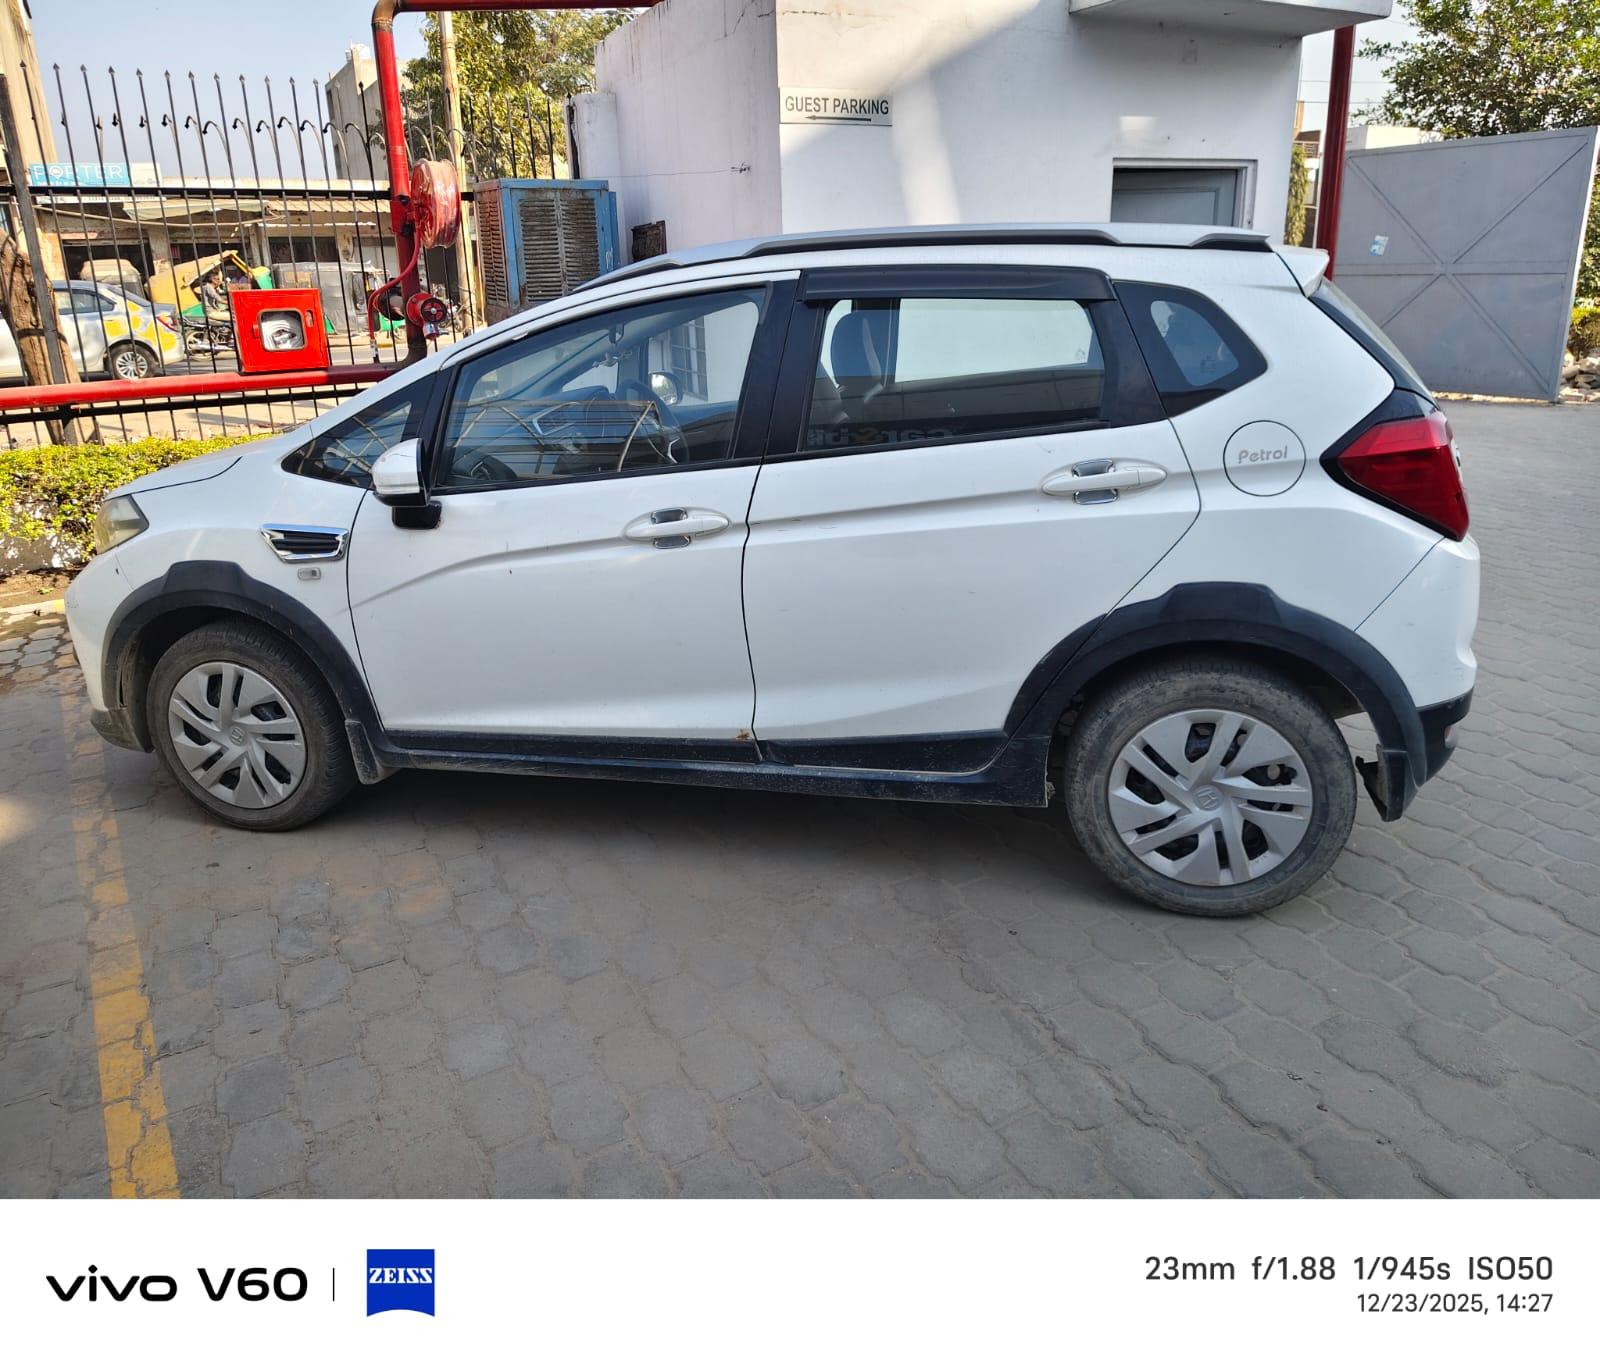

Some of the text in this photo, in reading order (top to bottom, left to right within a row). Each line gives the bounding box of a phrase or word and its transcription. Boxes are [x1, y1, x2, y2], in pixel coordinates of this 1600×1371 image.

[785, 96, 889, 115] GUEST PARKING
[1238, 445, 1288, 465] Petrol
